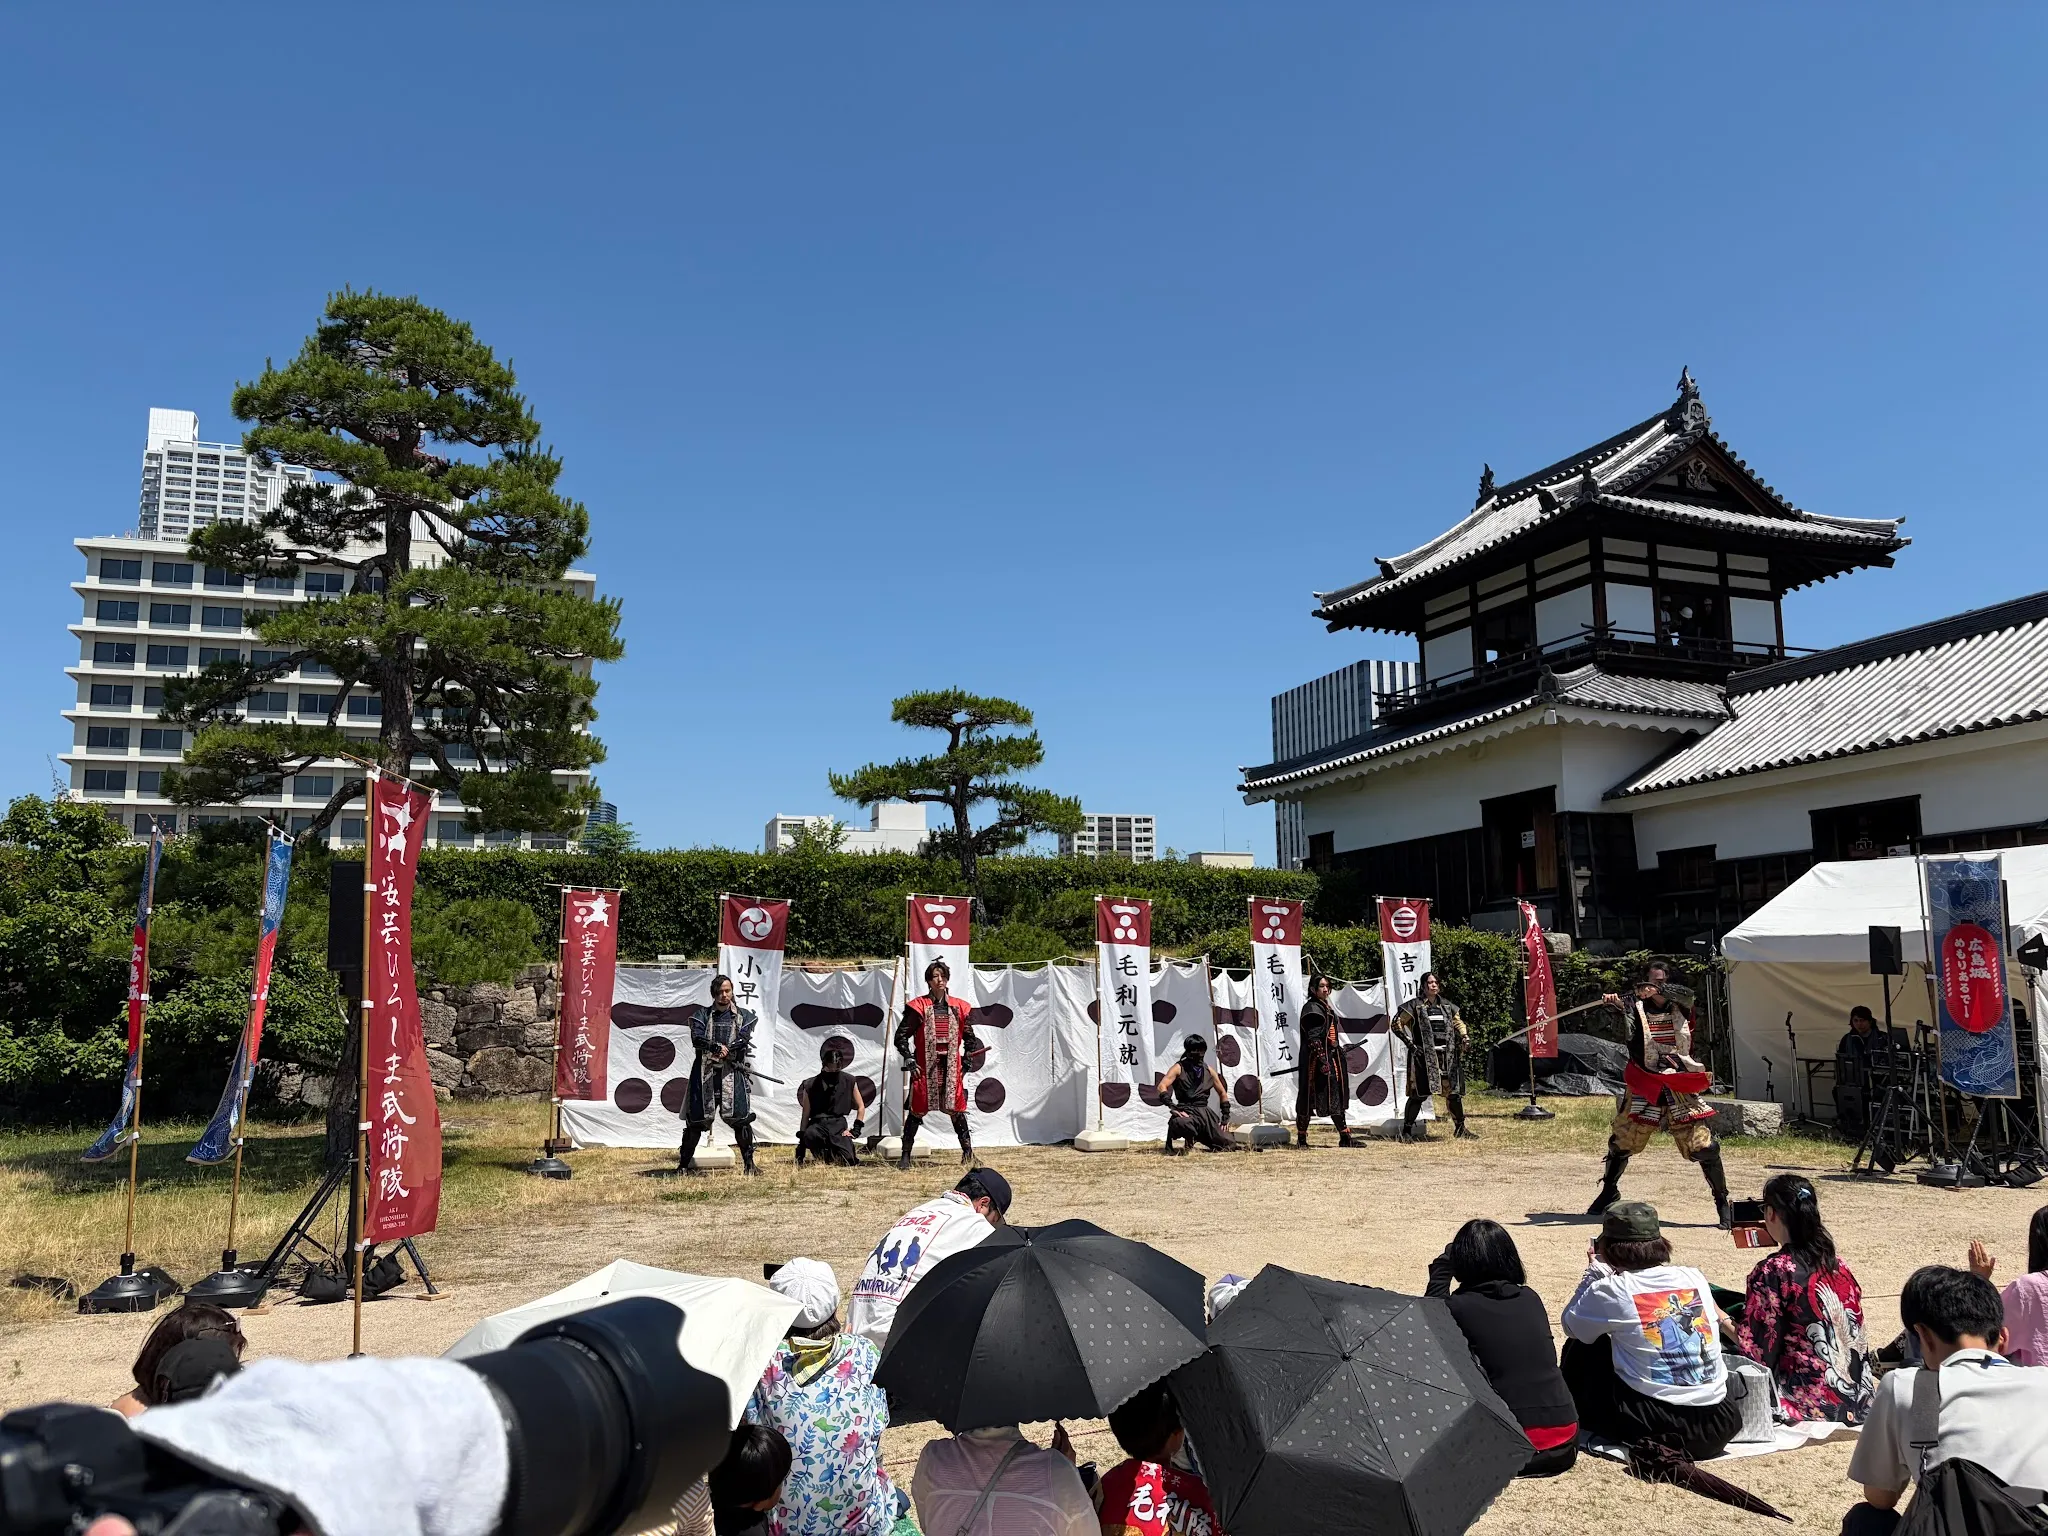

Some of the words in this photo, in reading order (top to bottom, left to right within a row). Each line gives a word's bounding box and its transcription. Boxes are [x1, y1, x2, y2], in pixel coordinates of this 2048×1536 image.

[572, 931, 599, 1084] 安芸ひろしま武将隊
[1115, 954, 1139, 1066] 毛利元就
[1267, 954, 1293, 1061] 毛利輝元
[1968, 938, 1992, 980] 広島城
[380, 869, 416, 1202] 安芸ひろしま武将隊
